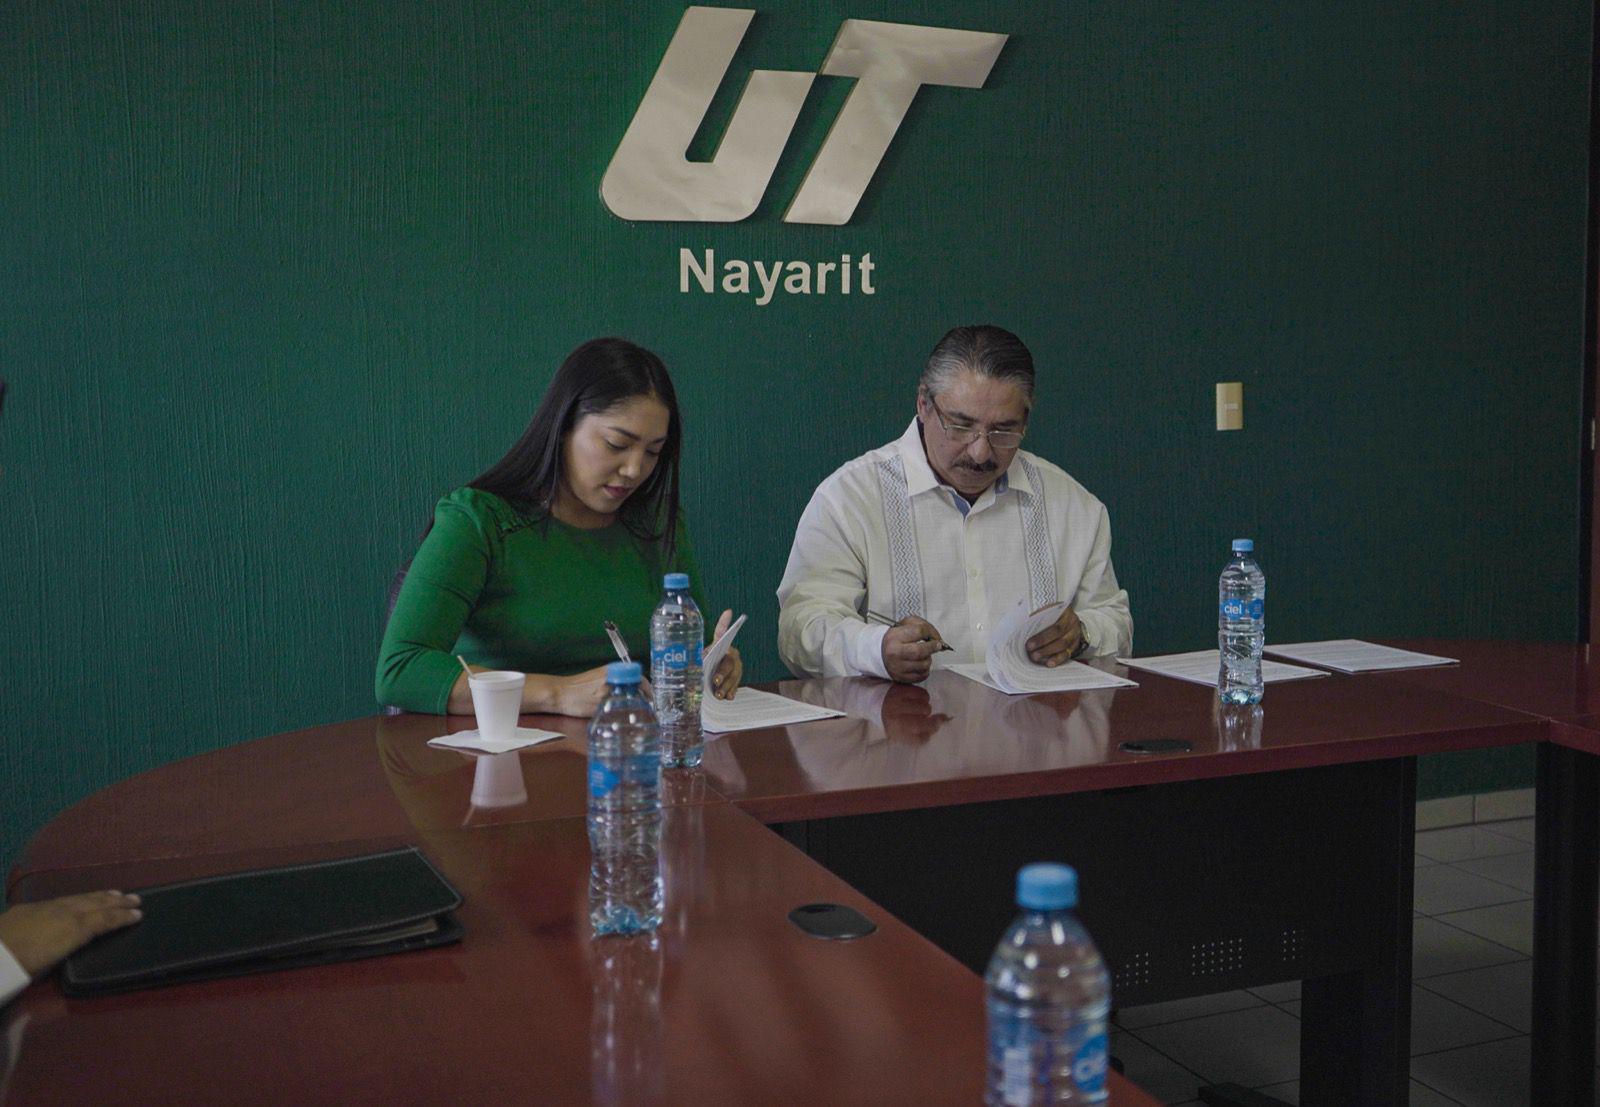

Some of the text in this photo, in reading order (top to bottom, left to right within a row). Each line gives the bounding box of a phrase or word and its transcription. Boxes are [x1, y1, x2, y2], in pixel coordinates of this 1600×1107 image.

[680, 247, 875, 305] Nayarit
[1224, 602, 1242, 615] ciel
[663, 648, 687, 662] ciel
